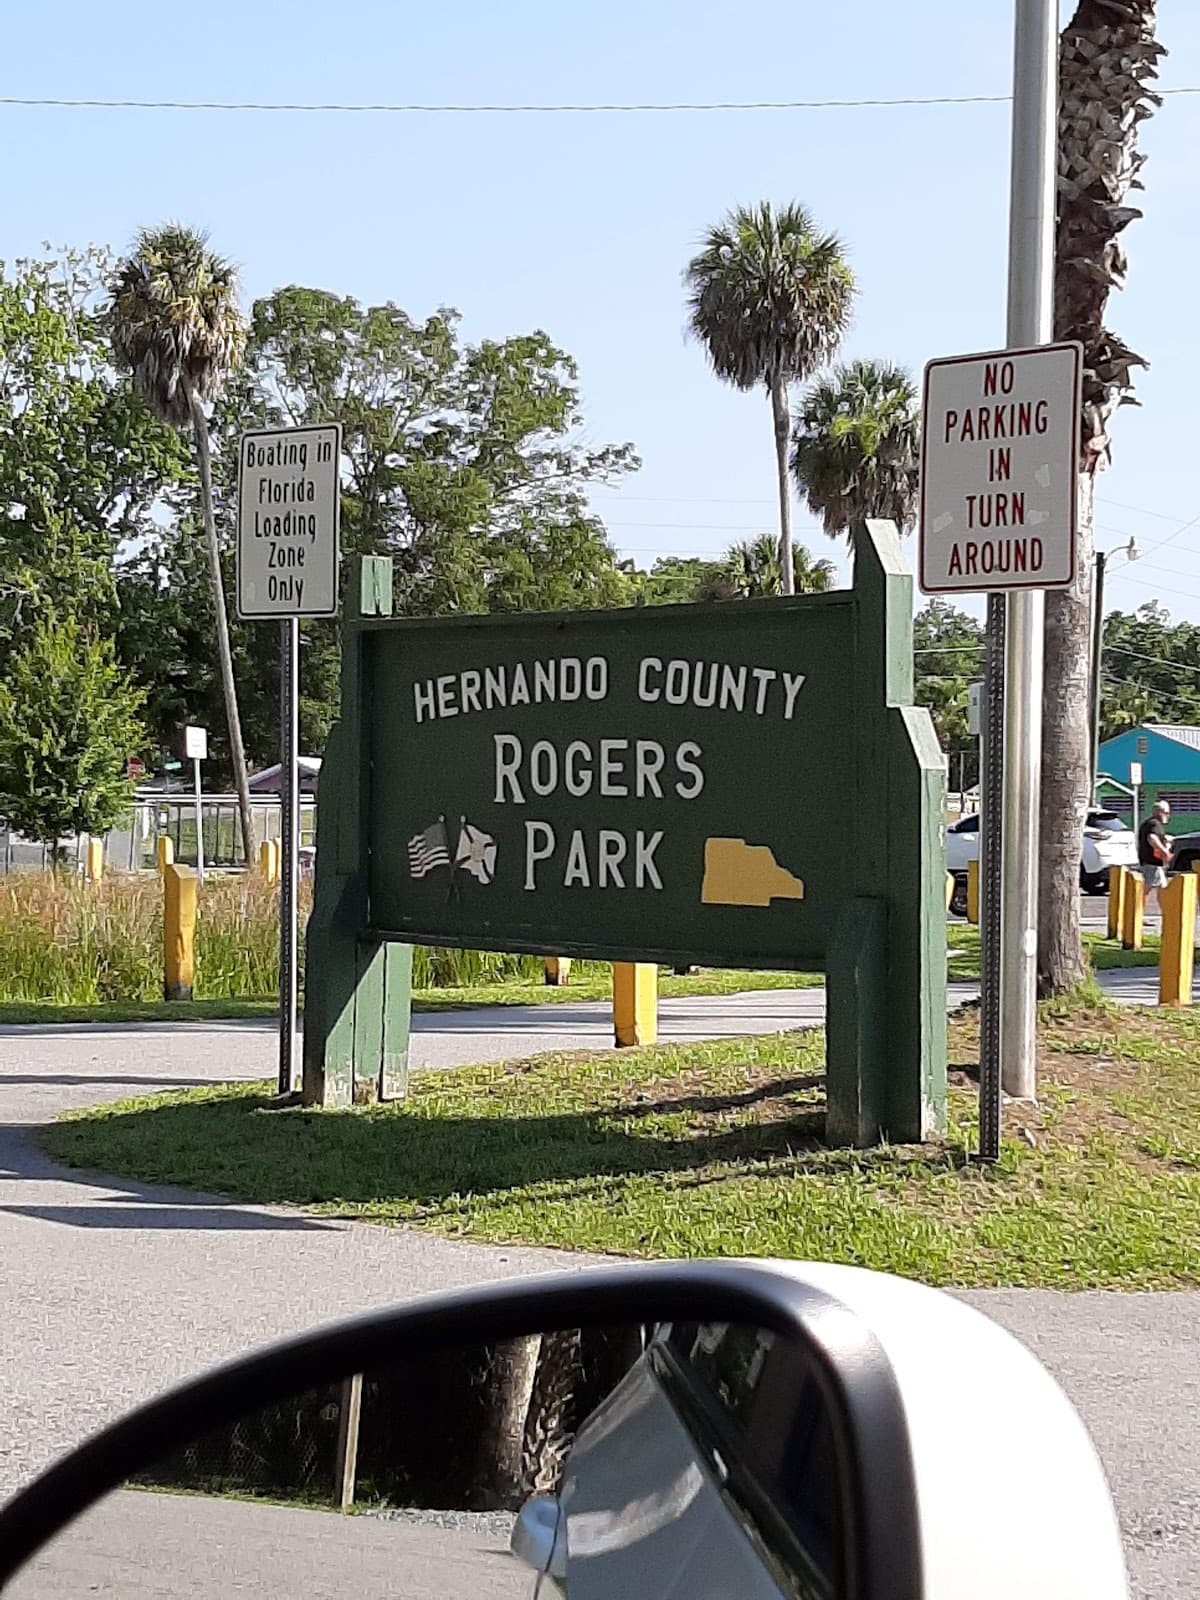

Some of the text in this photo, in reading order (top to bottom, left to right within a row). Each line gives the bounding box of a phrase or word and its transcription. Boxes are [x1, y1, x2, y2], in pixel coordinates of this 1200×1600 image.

[984, 361, 1014, 397] NO
[945, 400, 1048, 443] PARKING
[247, 434, 331, 471] Boating in
[989, 448, 1010, 482] IN
[259, 476, 315, 504] Florida
[255, 509, 316, 543] Loading
[966, 492, 1025, 529] TURN
[268, 542, 305, 568] Zone
[948, 537, 1043, 576] AROUND
[268, 575, 304, 608] Only
[413, 657, 806, 723] HERNANDO COUNTY
[493, 734, 705, 804] ROGERS
[523, 821, 665, 890] PARK
